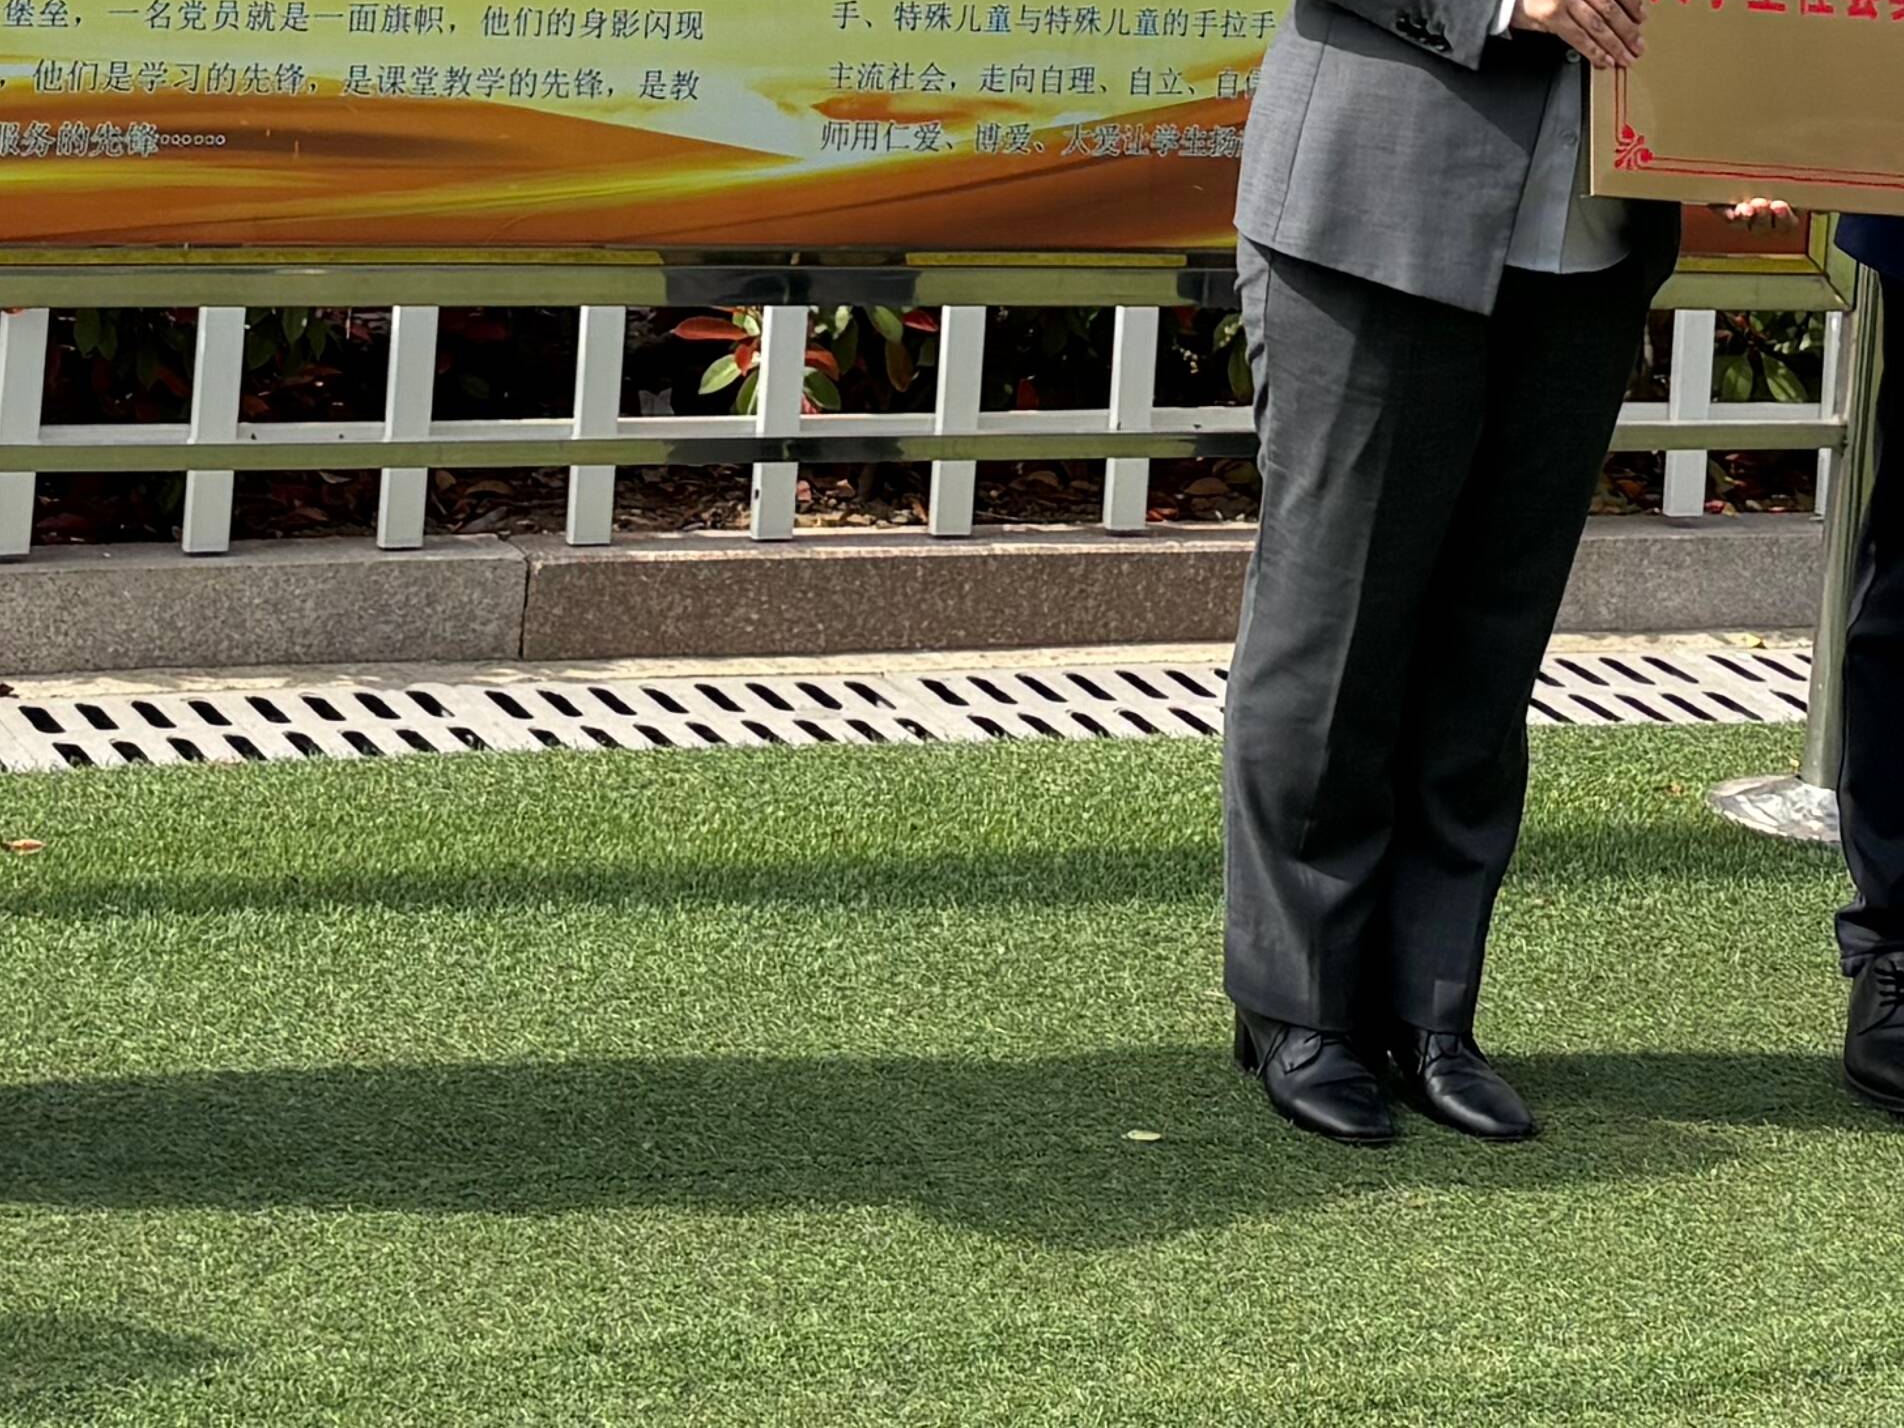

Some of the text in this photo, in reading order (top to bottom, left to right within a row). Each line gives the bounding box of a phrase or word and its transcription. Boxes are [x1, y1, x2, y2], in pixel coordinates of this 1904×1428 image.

[820, 120, 1243, 160] 师用仁爱、博爱、大爱让学生扬
